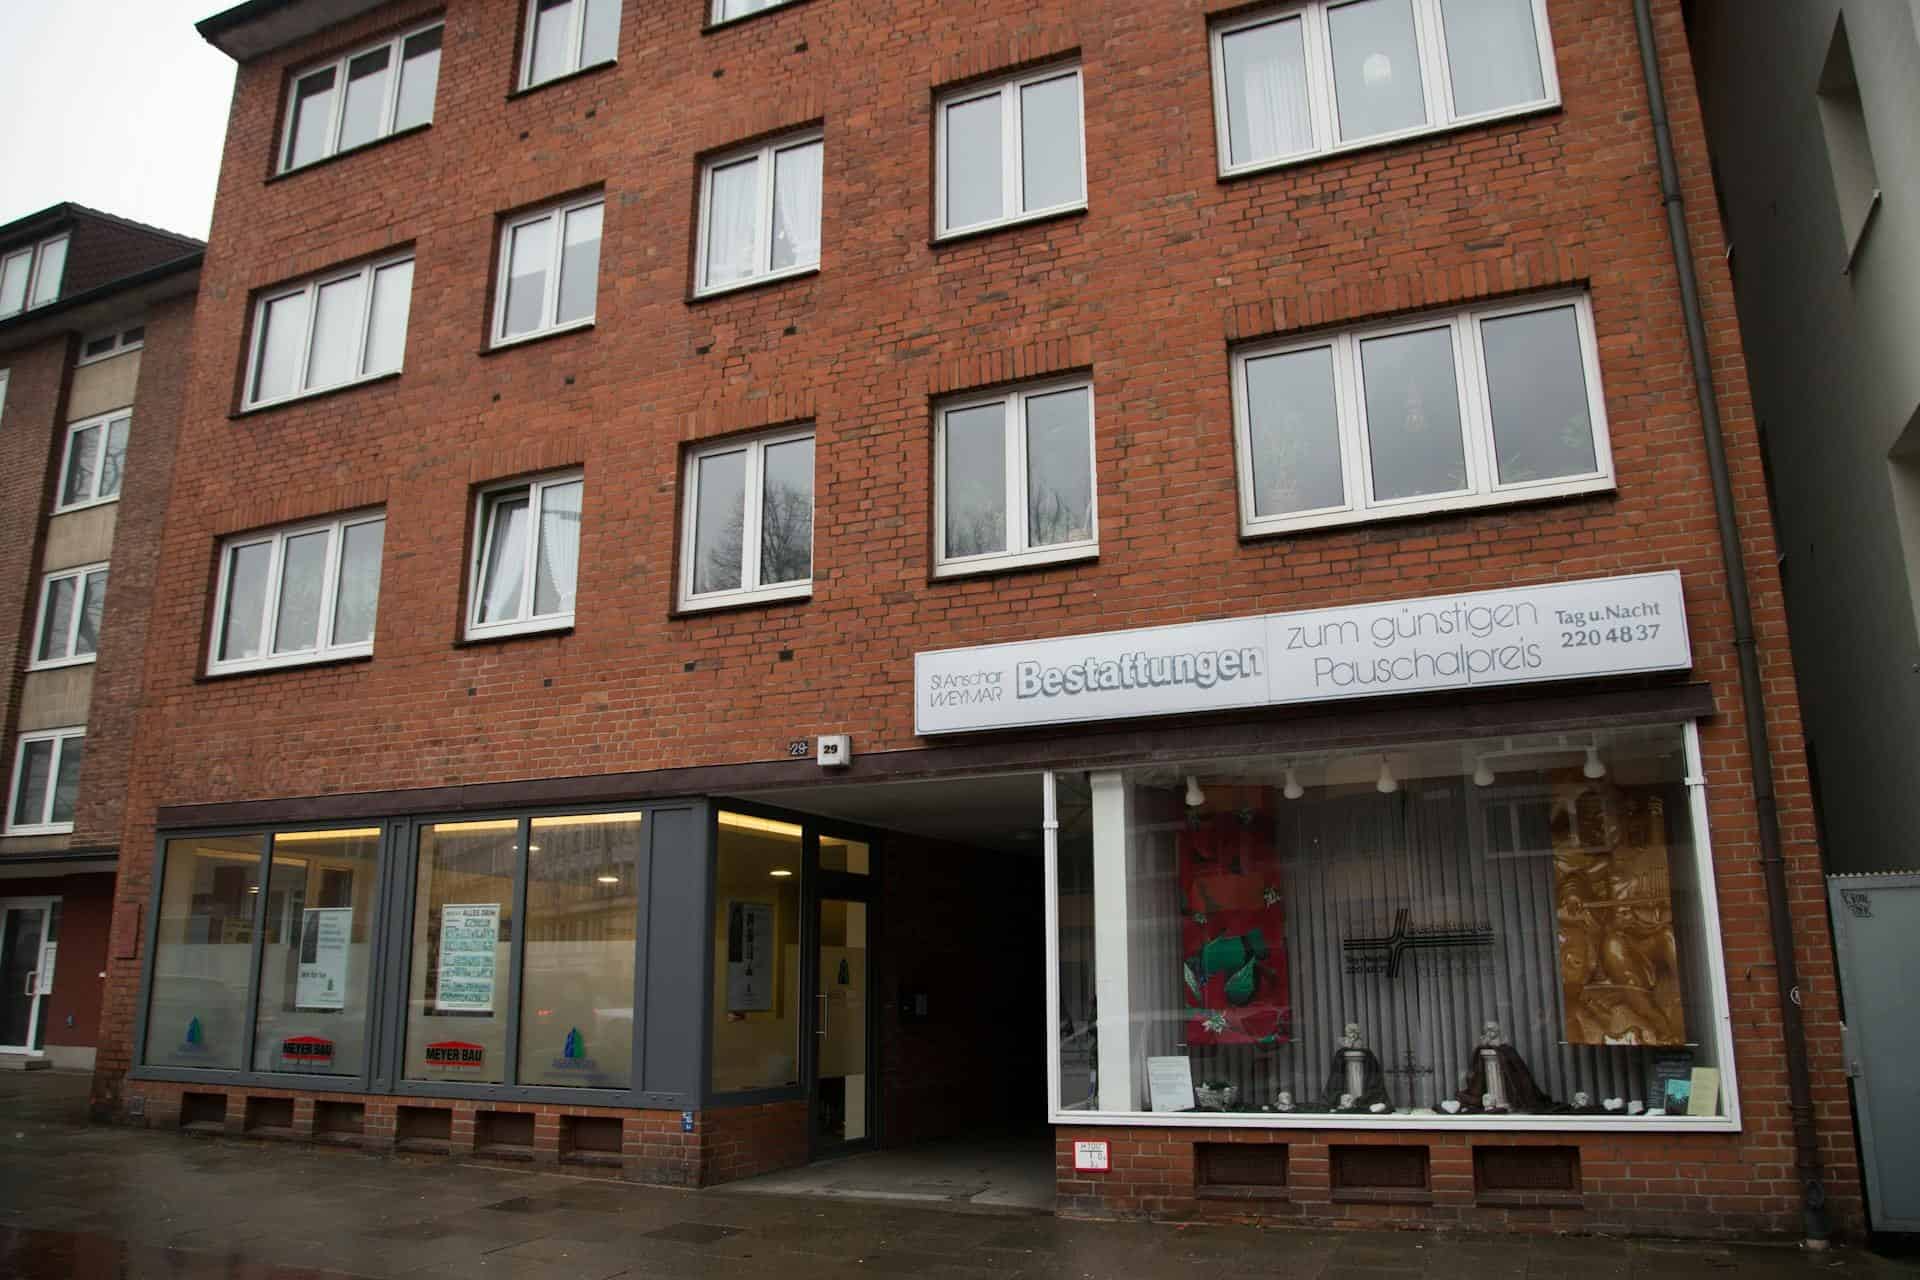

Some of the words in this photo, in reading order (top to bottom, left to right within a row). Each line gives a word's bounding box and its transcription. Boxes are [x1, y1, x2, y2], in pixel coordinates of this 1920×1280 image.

[1287, 621, 1360, 650] zum
[1371, 598, 1538, 648] günstigen
[1554, 609, 1587, 628] Tag
[1561, 628, 1602, 648] 220
[1015, 646, 1264, 700] Bestattungen
[1313, 637, 1544, 689] Pauschalpreis
[929, 686, 1003, 708] WEYMAR
[823, 744, 838, 754] 29
[282, 1042, 314, 1056] MEYER
[314, 1044, 333, 1056] BAU
[426, 1047, 460, 1061] MEYER
[461, 1049, 482, 1062] BAU
